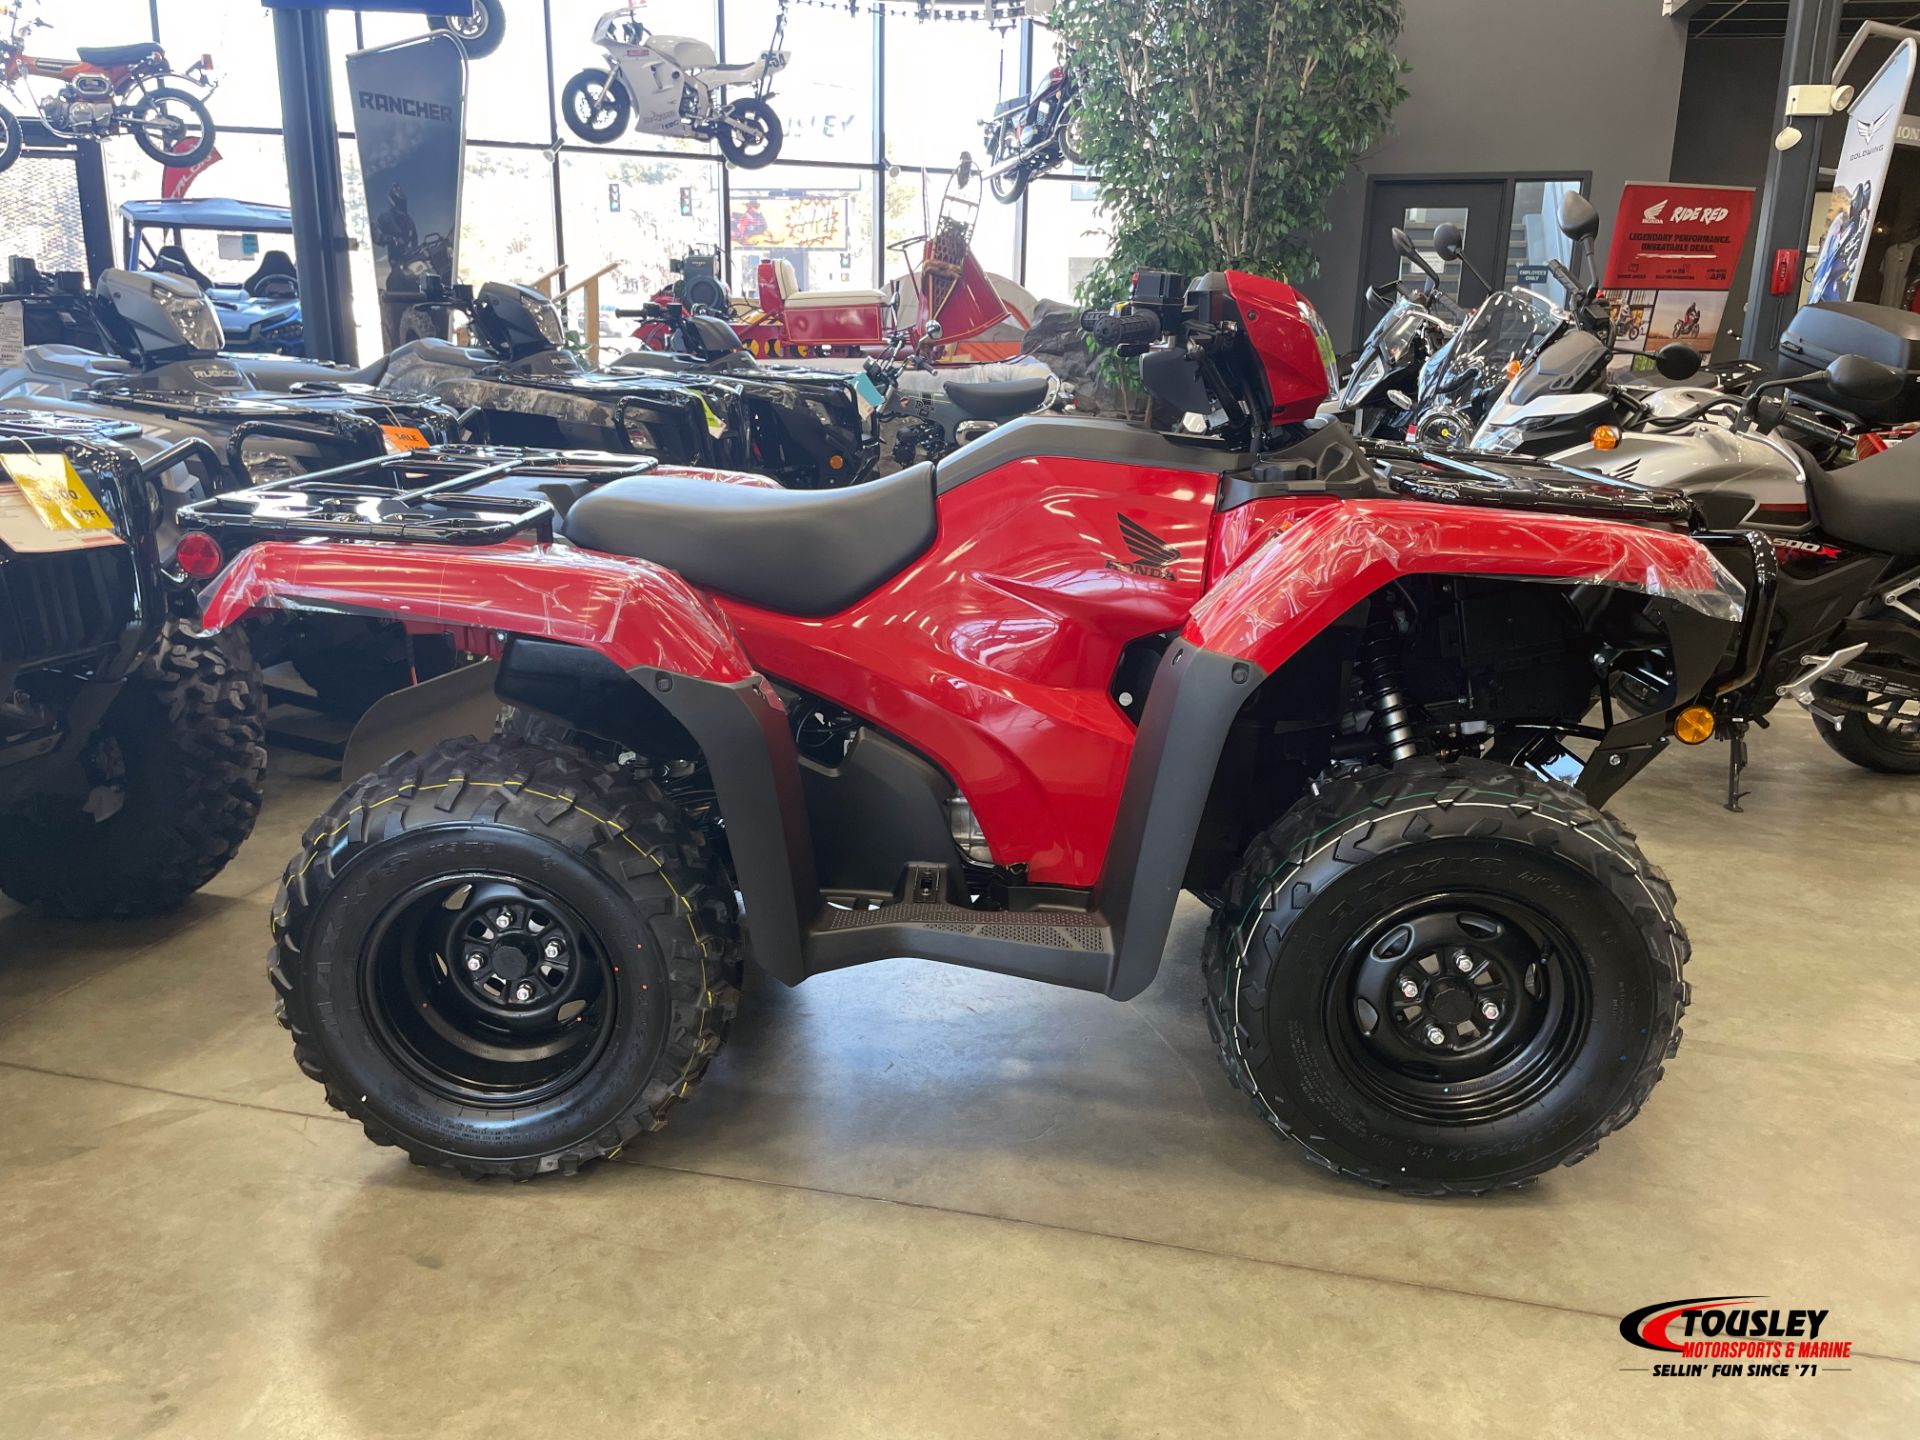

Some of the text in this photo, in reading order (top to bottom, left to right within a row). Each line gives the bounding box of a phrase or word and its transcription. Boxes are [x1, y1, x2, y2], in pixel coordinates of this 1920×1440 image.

[358, 90, 453, 121] RANCHER
[1669, 206, 1729, 225] RIDE RED
[1629, 233, 1672, 242] LEGENDARY
[193, 369, 237, 378] RUBICO
[1105, 559, 1177, 582] HONDA
